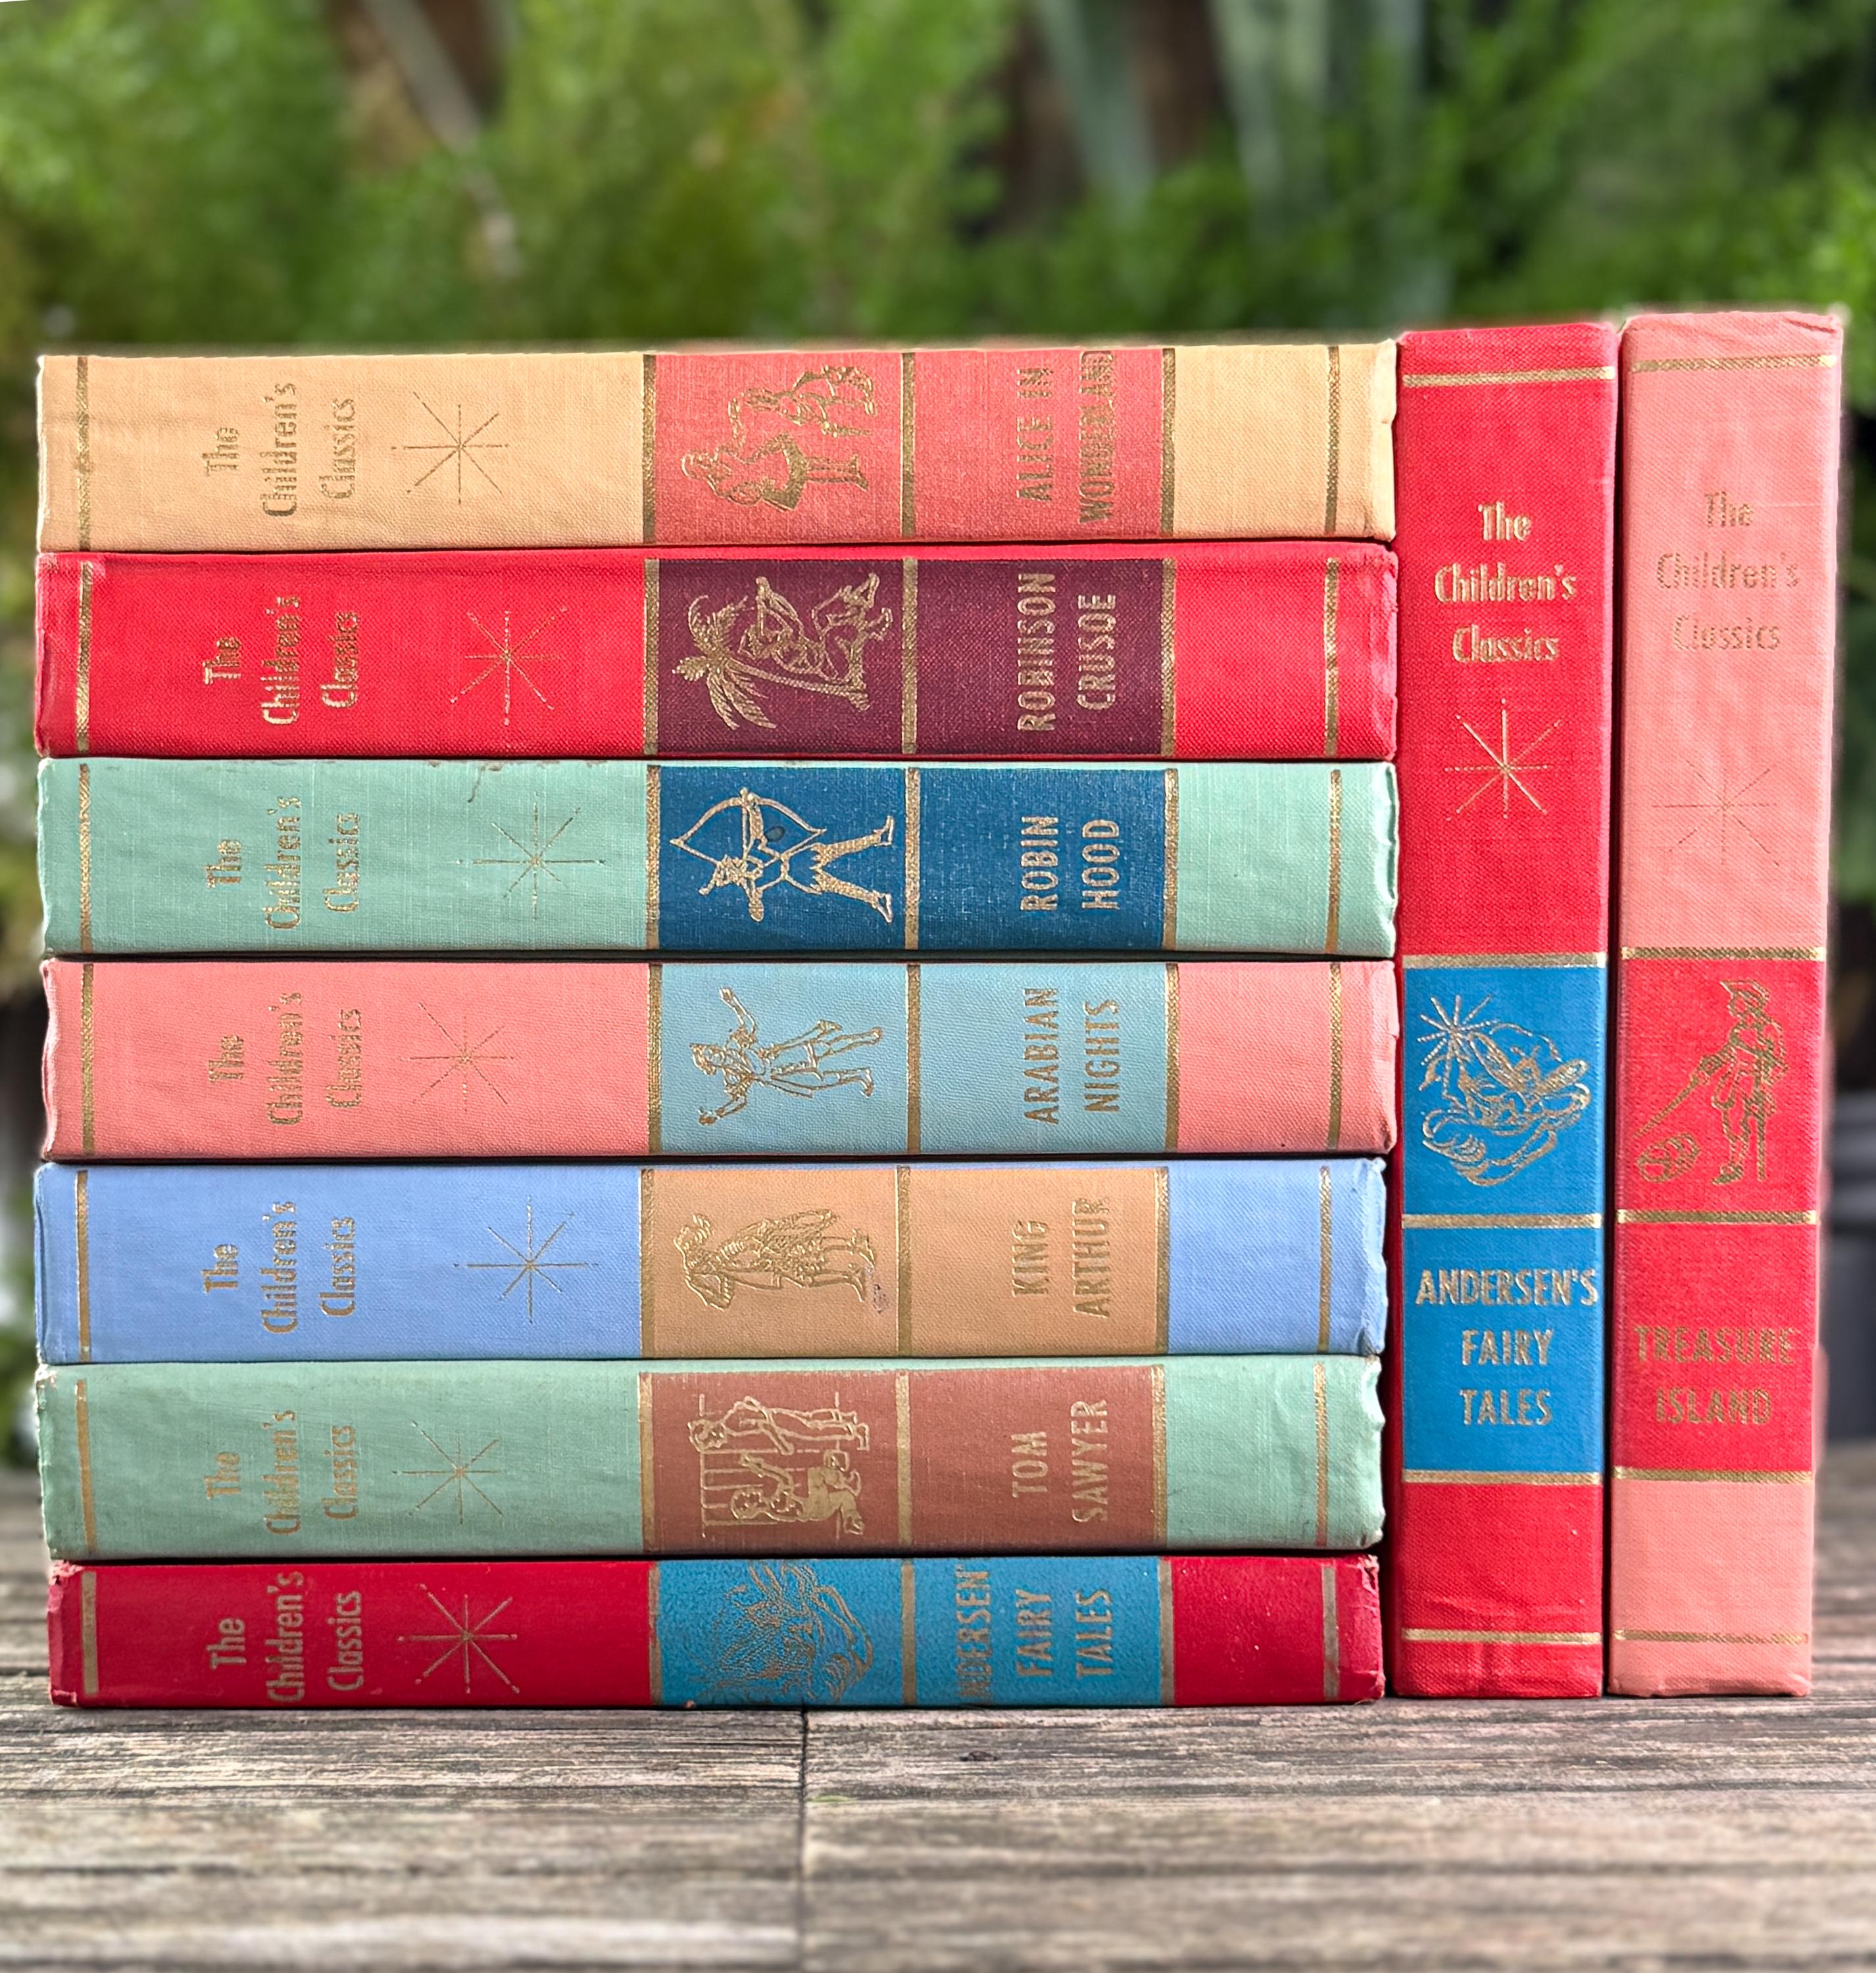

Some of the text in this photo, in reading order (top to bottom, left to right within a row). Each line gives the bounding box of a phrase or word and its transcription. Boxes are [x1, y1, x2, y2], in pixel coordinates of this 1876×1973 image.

[201, 426, 240, 476] The
[260, 382, 298, 517] Children's
[319, 398, 356, 499] Classics
[1017, 367, 1054, 502] ALICE IN
[1079, 350, 1116, 525] WONDERLAND
[1477, 500, 1531, 541] The
[1704, 490, 1754, 527] The
[1434, 562, 1577, 603] Children's
[1656, 552, 1800, 589] Children's
[203, 637, 241, 685] The
[261, 596, 300, 725] Children's
[320, 611, 359, 708] Classics
[1018, 573, 1056, 732] ROBINSON
[1077, 595, 1116, 710] CRUSOE
[1452, 623, 1560, 664] Classics
[1673, 614, 1780, 651] Classics
[205, 839, 243, 889] The
[262, 796, 301, 930] Children's
[323, 812, 360, 913] Classics
[1020, 816, 1059, 911] ROBIN
[1081, 819, 1120, 910] HOOD
[209, 1035, 245, 1083] The
[266, 992, 303, 1125] Children's
[326, 1008, 362, 1108] Classics
[1023, 987, 1060, 1125] ARABIAN
[1084, 998, 1120, 1113] NIGHTS
[201, 1244, 239, 1294] The
[260, 1200, 298, 1335] Children's
[319, 1216, 356, 1317] Classics
[1012, 1219, 1050, 1298] KING
[1072, 1198, 1110, 1319] ARTHUR
[1415, 1268, 1599, 1307] ANDERSEN'S
[1461, 1328, 1554, 1367] FAIRY
[1634, 1326, 1798, 1365] TREASURE
[1460, 1388, 1553, 1426] TALES
[1656, 1388, 1772, 1426] ISLAND
[203, 1451, 242, 1500] The
[261, 1409, 301, 1537] Children's
[321, 1425, 359, 1521] Classics
[1011, 1430, 1049, 1499] TOM
[1071, 1400, 1109, 1523] SAWYER
[207, 1617, 247, 1671] The
[265, 1570, 305, 1703] Children's
[327, 1590, 364, 1692] Classics
[1015, 1589, 1052, 1677] FAIRY
[1075, 1589, 1113, 1680] TALES
